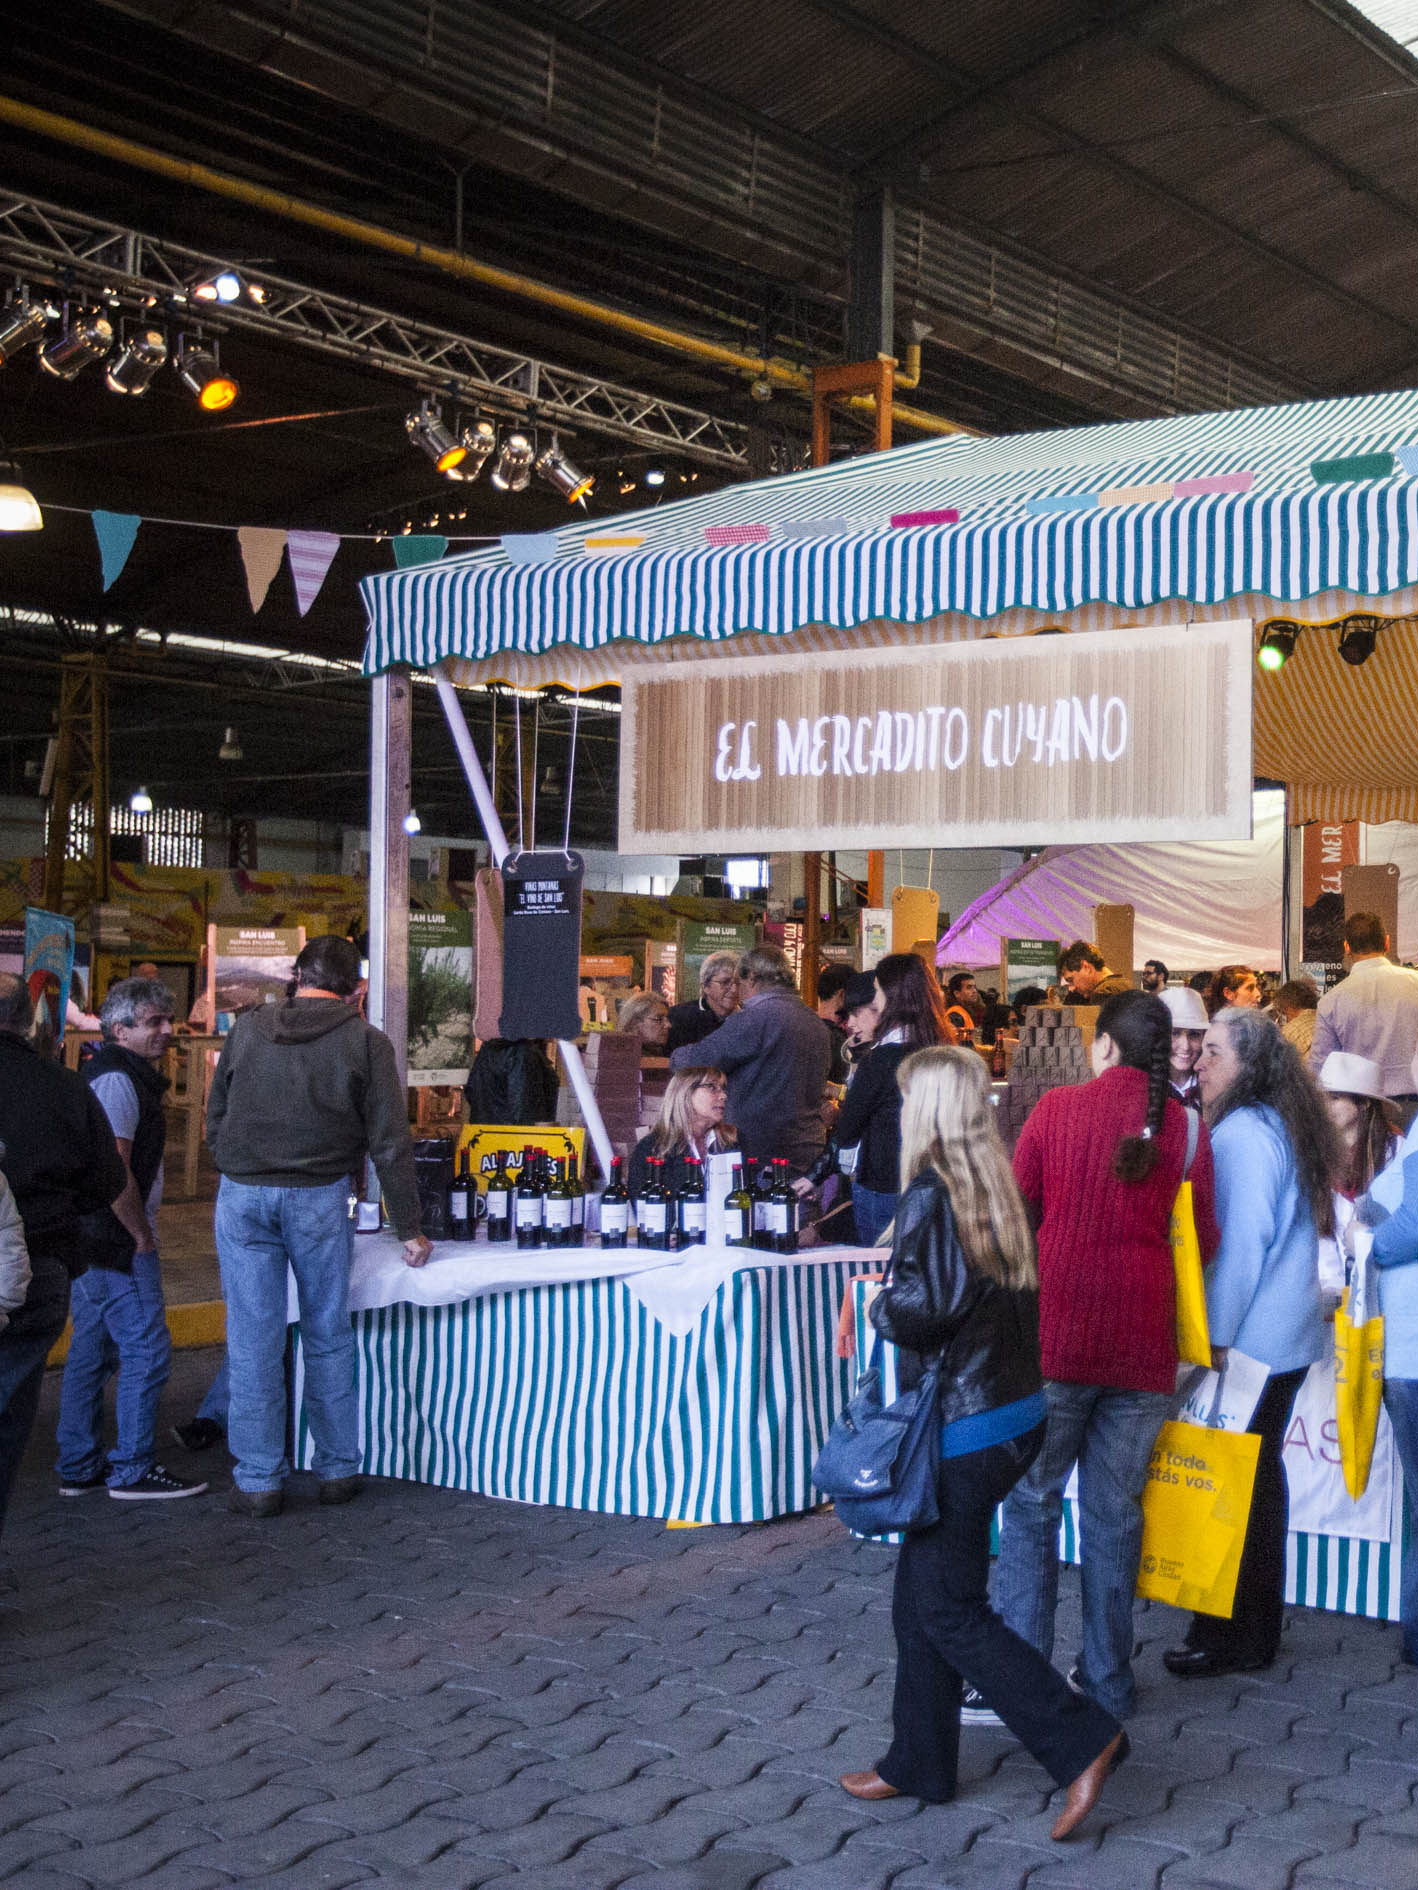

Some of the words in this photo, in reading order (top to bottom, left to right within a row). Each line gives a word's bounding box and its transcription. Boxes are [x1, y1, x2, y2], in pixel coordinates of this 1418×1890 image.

[715, 720, 761, 781] EL
[775, 706, 969, 776] MERCADITO
[981, 695, 1129, 768] CUYANO
[427, 914, 446, 924] LUIS
[240, 930, 257, 939] SAN
[258, 930, 276, 940] LUIS
[705, 926, 720, 935] SAN
[721, 927, 737, 936] LUIS
[1147, 1466, 1180, 1485] stás
